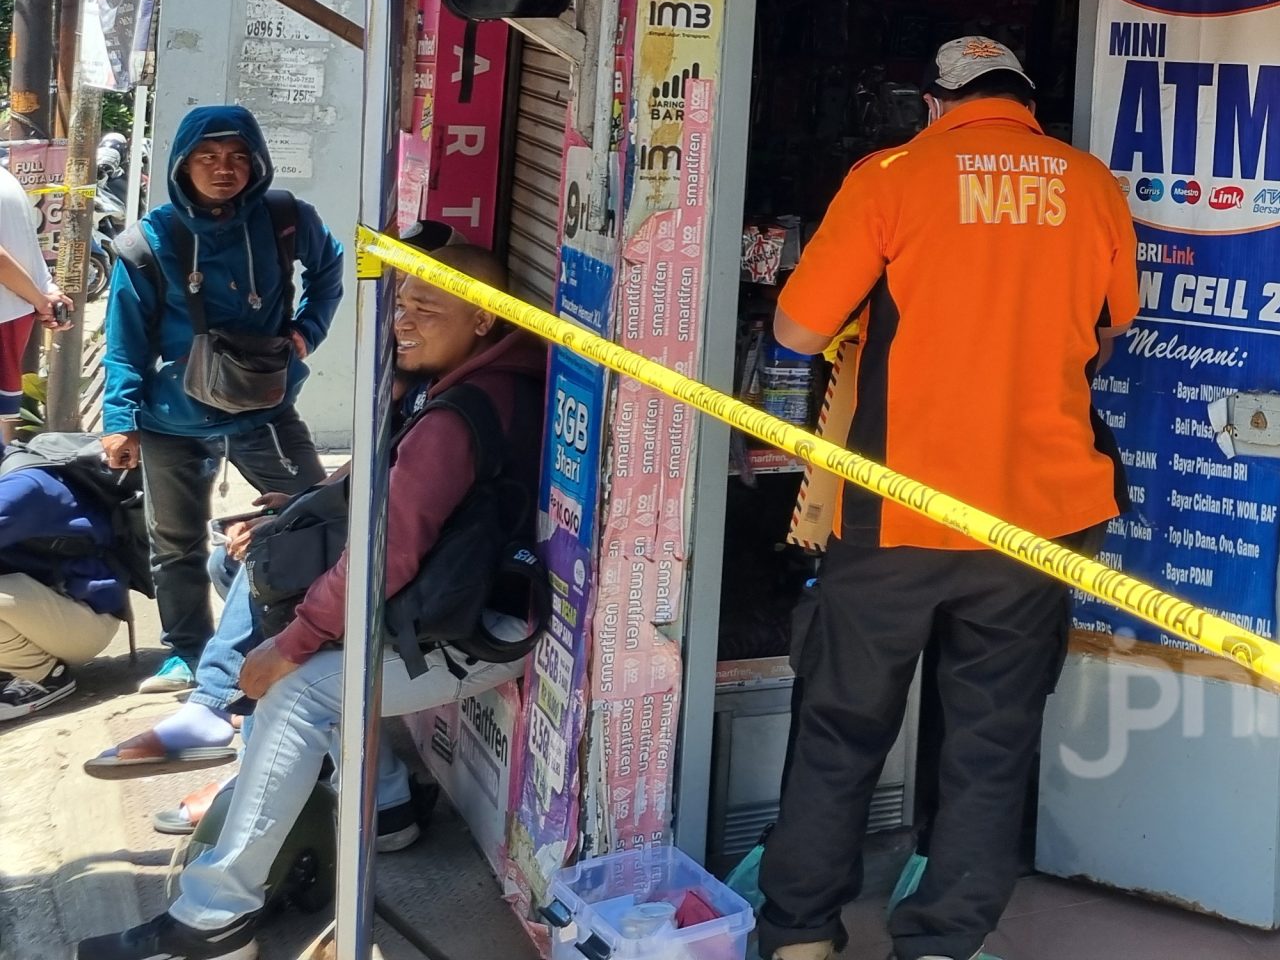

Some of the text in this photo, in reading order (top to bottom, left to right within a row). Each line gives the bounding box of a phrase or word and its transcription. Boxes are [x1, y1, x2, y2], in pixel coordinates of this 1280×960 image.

[1109, 22, 1166, 57] MINI
[15, 162, 44, 174] FULL
[687, 132, 700, 207] smartfren
[956, 154, 1068, 175] TEAM OLAH TKP
[959, 174, 1067, 226] INAFIS
[1139, 186, 1242, 209] Cirrus Maestro Link
[626, 264, 642, 340] smartfren
[652, 261, 667, 337] smartfren
[677, 267, 693, 342] smartfren
[1171, 273, 1248, 319] CELL
[1126, 327, 1248, 369] Melayani:
[1109, 376, 1130, 394] Tunai
[1177, 381, 1199, 403] Bayar
[555, 389, 589, 452] 3GB
[617, 402, 633, 478] smartfren
[643, 398, 659, 474] smartfren
[669, 403, 684, 479] smartfren
[1106, 411, 1126, 429] Tunai
[1175, 417, 1190, 436] Beli
[1136, 451, 1157, 469] BANK
[1173, 453, 1248, 481] Bayar Pinjaman BRI
[1171, 490, 1278, 523] Bayar Cicilan FIF, WOM, BAF
[826, 447, 1205, 639] GARIS POLISI DILARANG MELINTAS
[1130, 522, 1152, 541] Token
[1168, 525, 1260, 559] Top Up Dana, Ovo, Game
[1166, 562, 1213, 587] Bayar PDAM
[625, 560, 645, 649] smartfren
[600, 603, 618, 693] smartfren
[1255, 617, 1272, 637] DLL
[620, 697, 635, 776] smartfren
[639, 694, 654, 772] smartfren
[656, 693, 673, 770] smartfren
